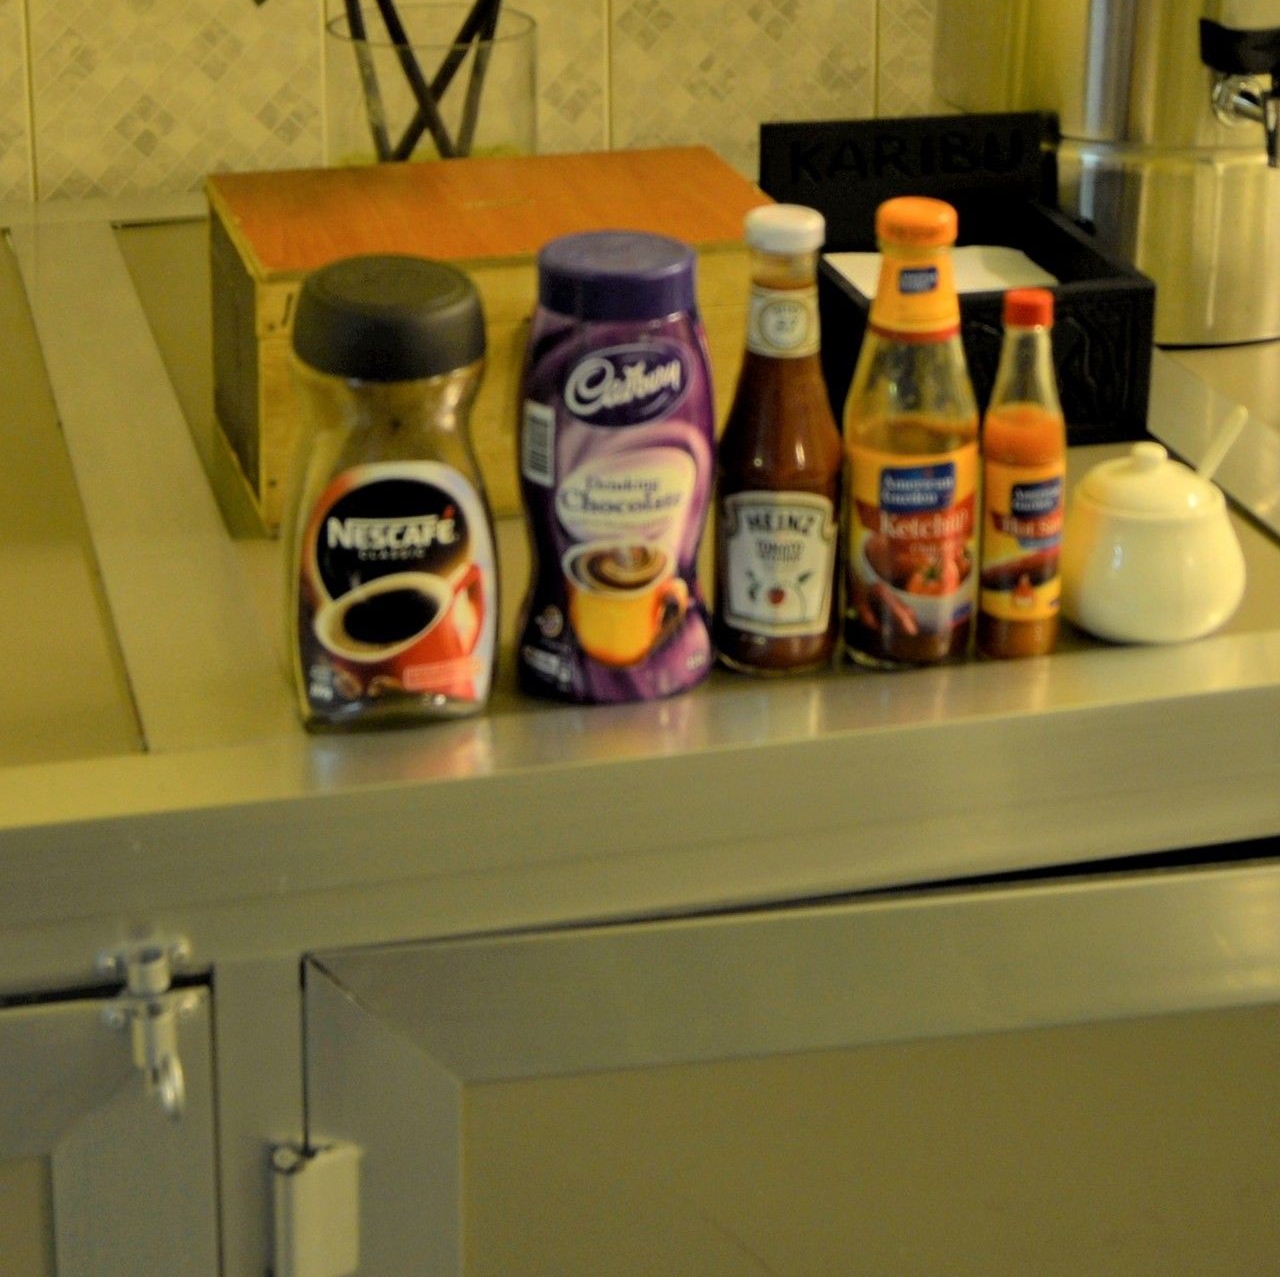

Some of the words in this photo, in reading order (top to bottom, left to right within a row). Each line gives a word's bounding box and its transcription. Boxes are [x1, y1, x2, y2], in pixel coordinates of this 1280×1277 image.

[791, 129, 1024, 184] KARIBU
[564, 357, 681, 416] Cadbury
[561, 487, 682, 514] Chocolate
[745, 513, 815, 535] HEINZ
